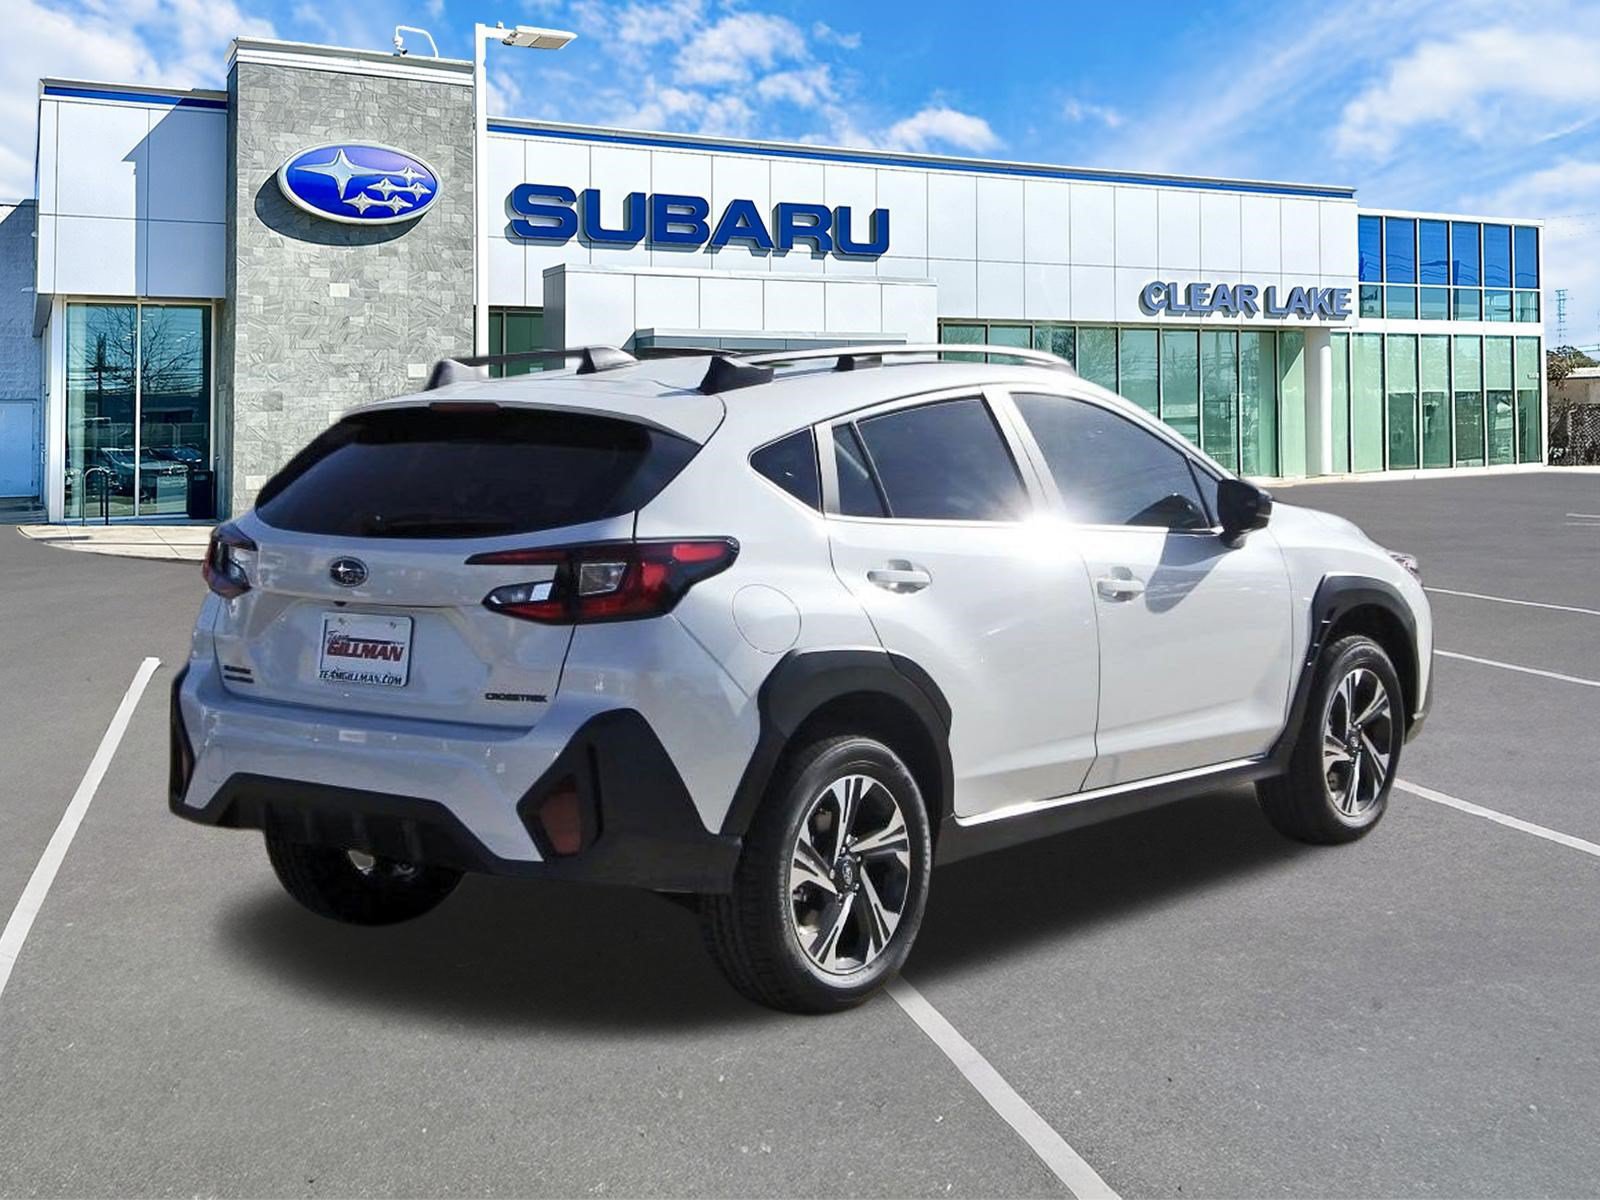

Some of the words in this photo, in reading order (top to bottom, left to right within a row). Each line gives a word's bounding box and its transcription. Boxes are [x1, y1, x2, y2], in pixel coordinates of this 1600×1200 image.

[506, 183, 890, 257] SUBARU
[1141, 281, 1260, 316] CLEAR
[1265, 286, 1352, 319] LAKE
[327, 641, 404, 662] GILLMAN
[319, 670, 402, 685] TEAMGILLMAN.COM
